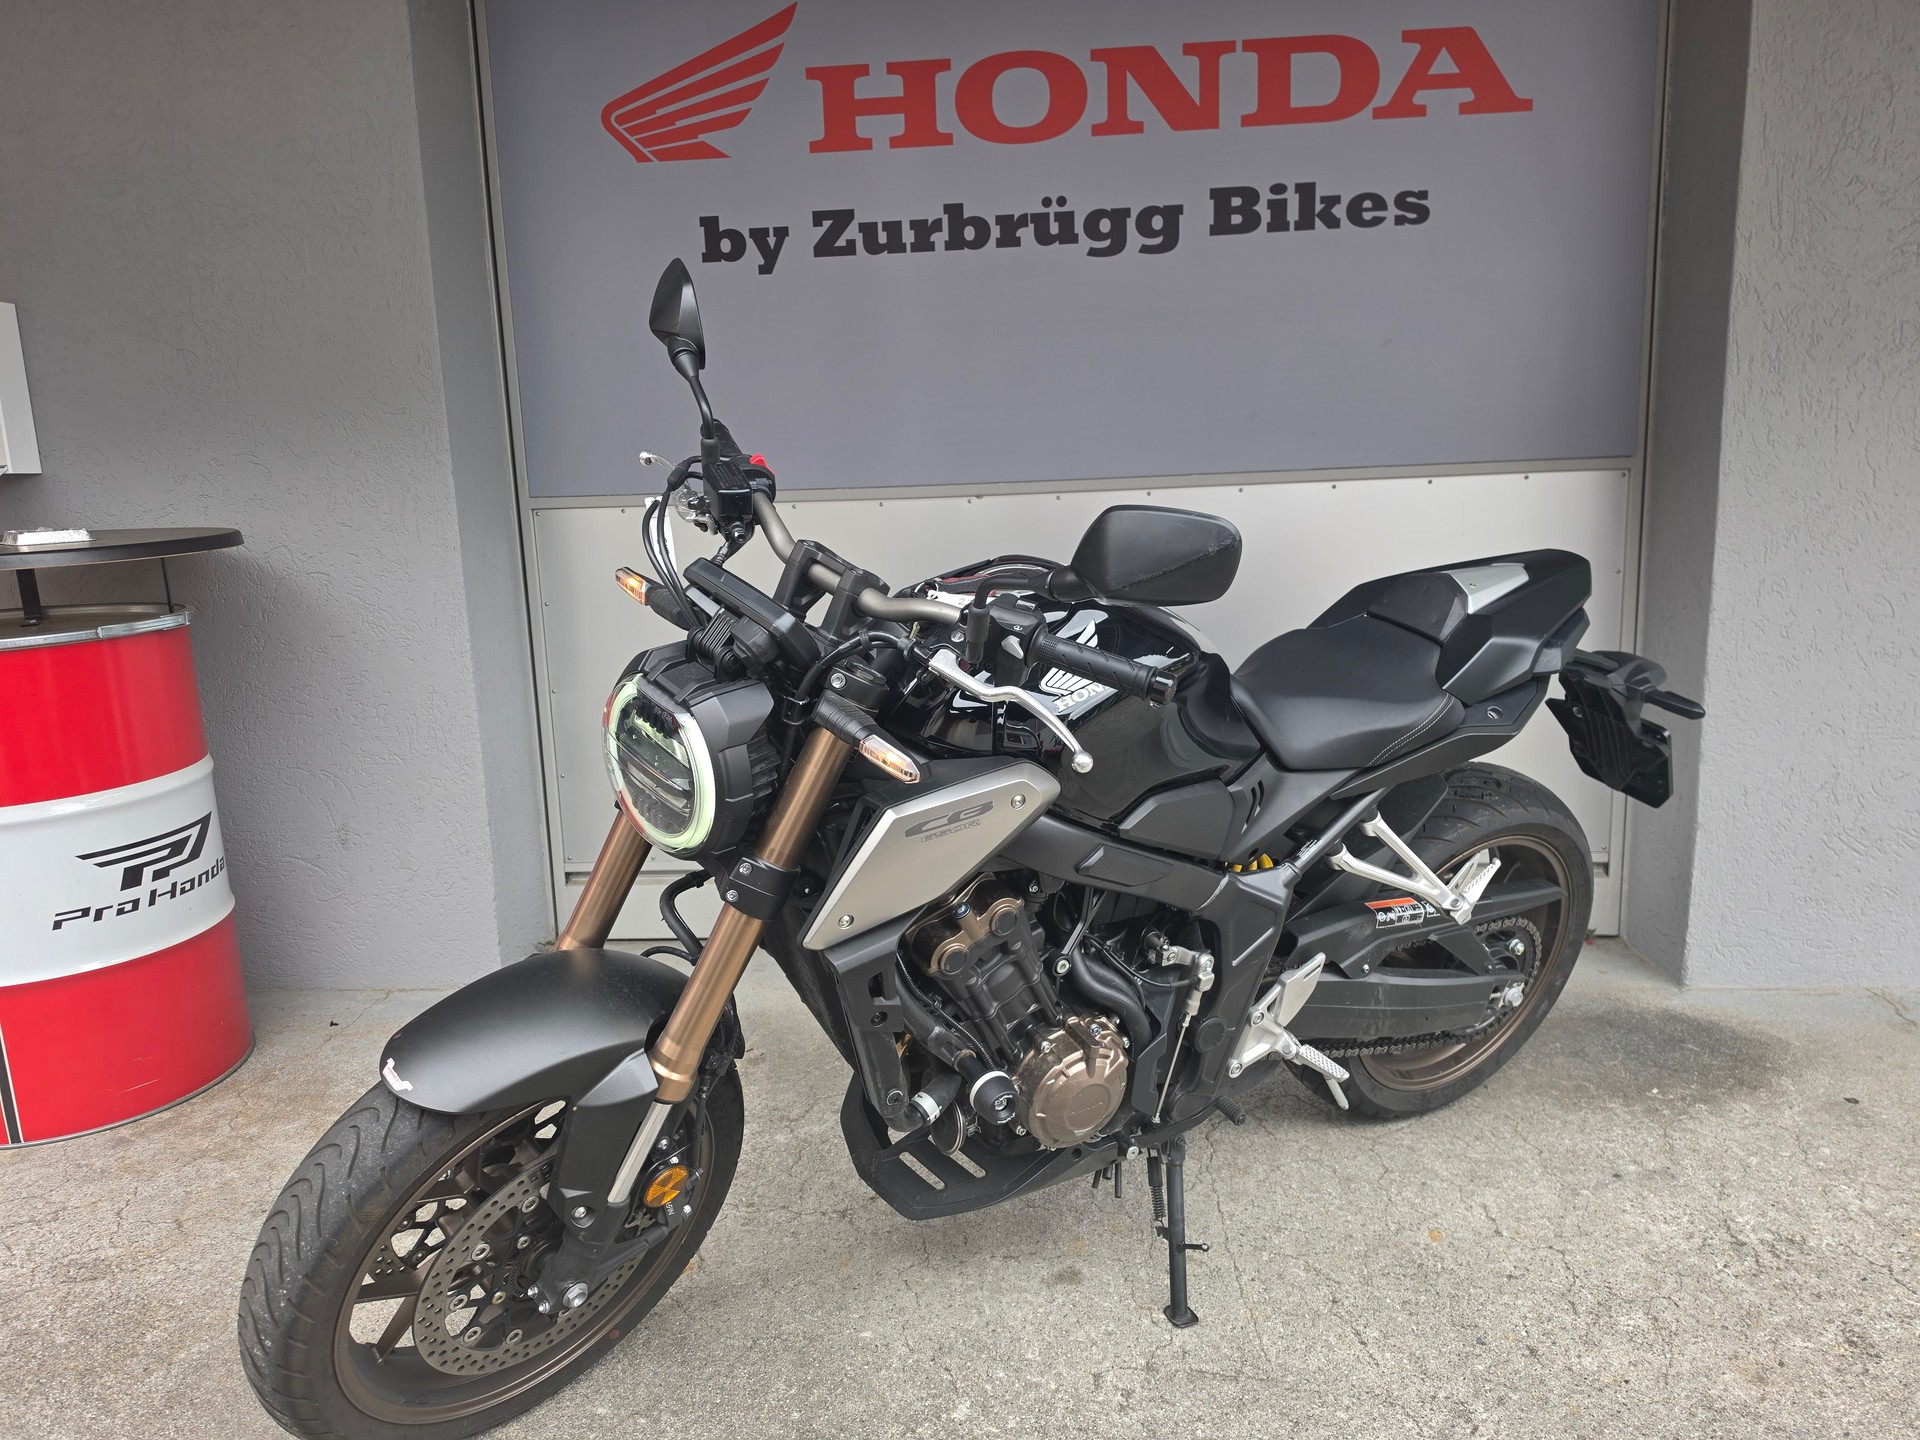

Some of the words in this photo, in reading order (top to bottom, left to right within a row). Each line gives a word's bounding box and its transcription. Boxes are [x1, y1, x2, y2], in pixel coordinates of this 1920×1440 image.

[804, 26, 1534, 154] HONDA
[698, 215, 790, 276] by
[811, 195, 1184, 258] Zurbrügg
[1209, 181, 1431, 237] Bikes
[1054, 682, 1110, 712] HON
[904, 800, 994, 838] CB
[52, 897, 141, 931] Pro
[147, 855, 225, 908] Honda
